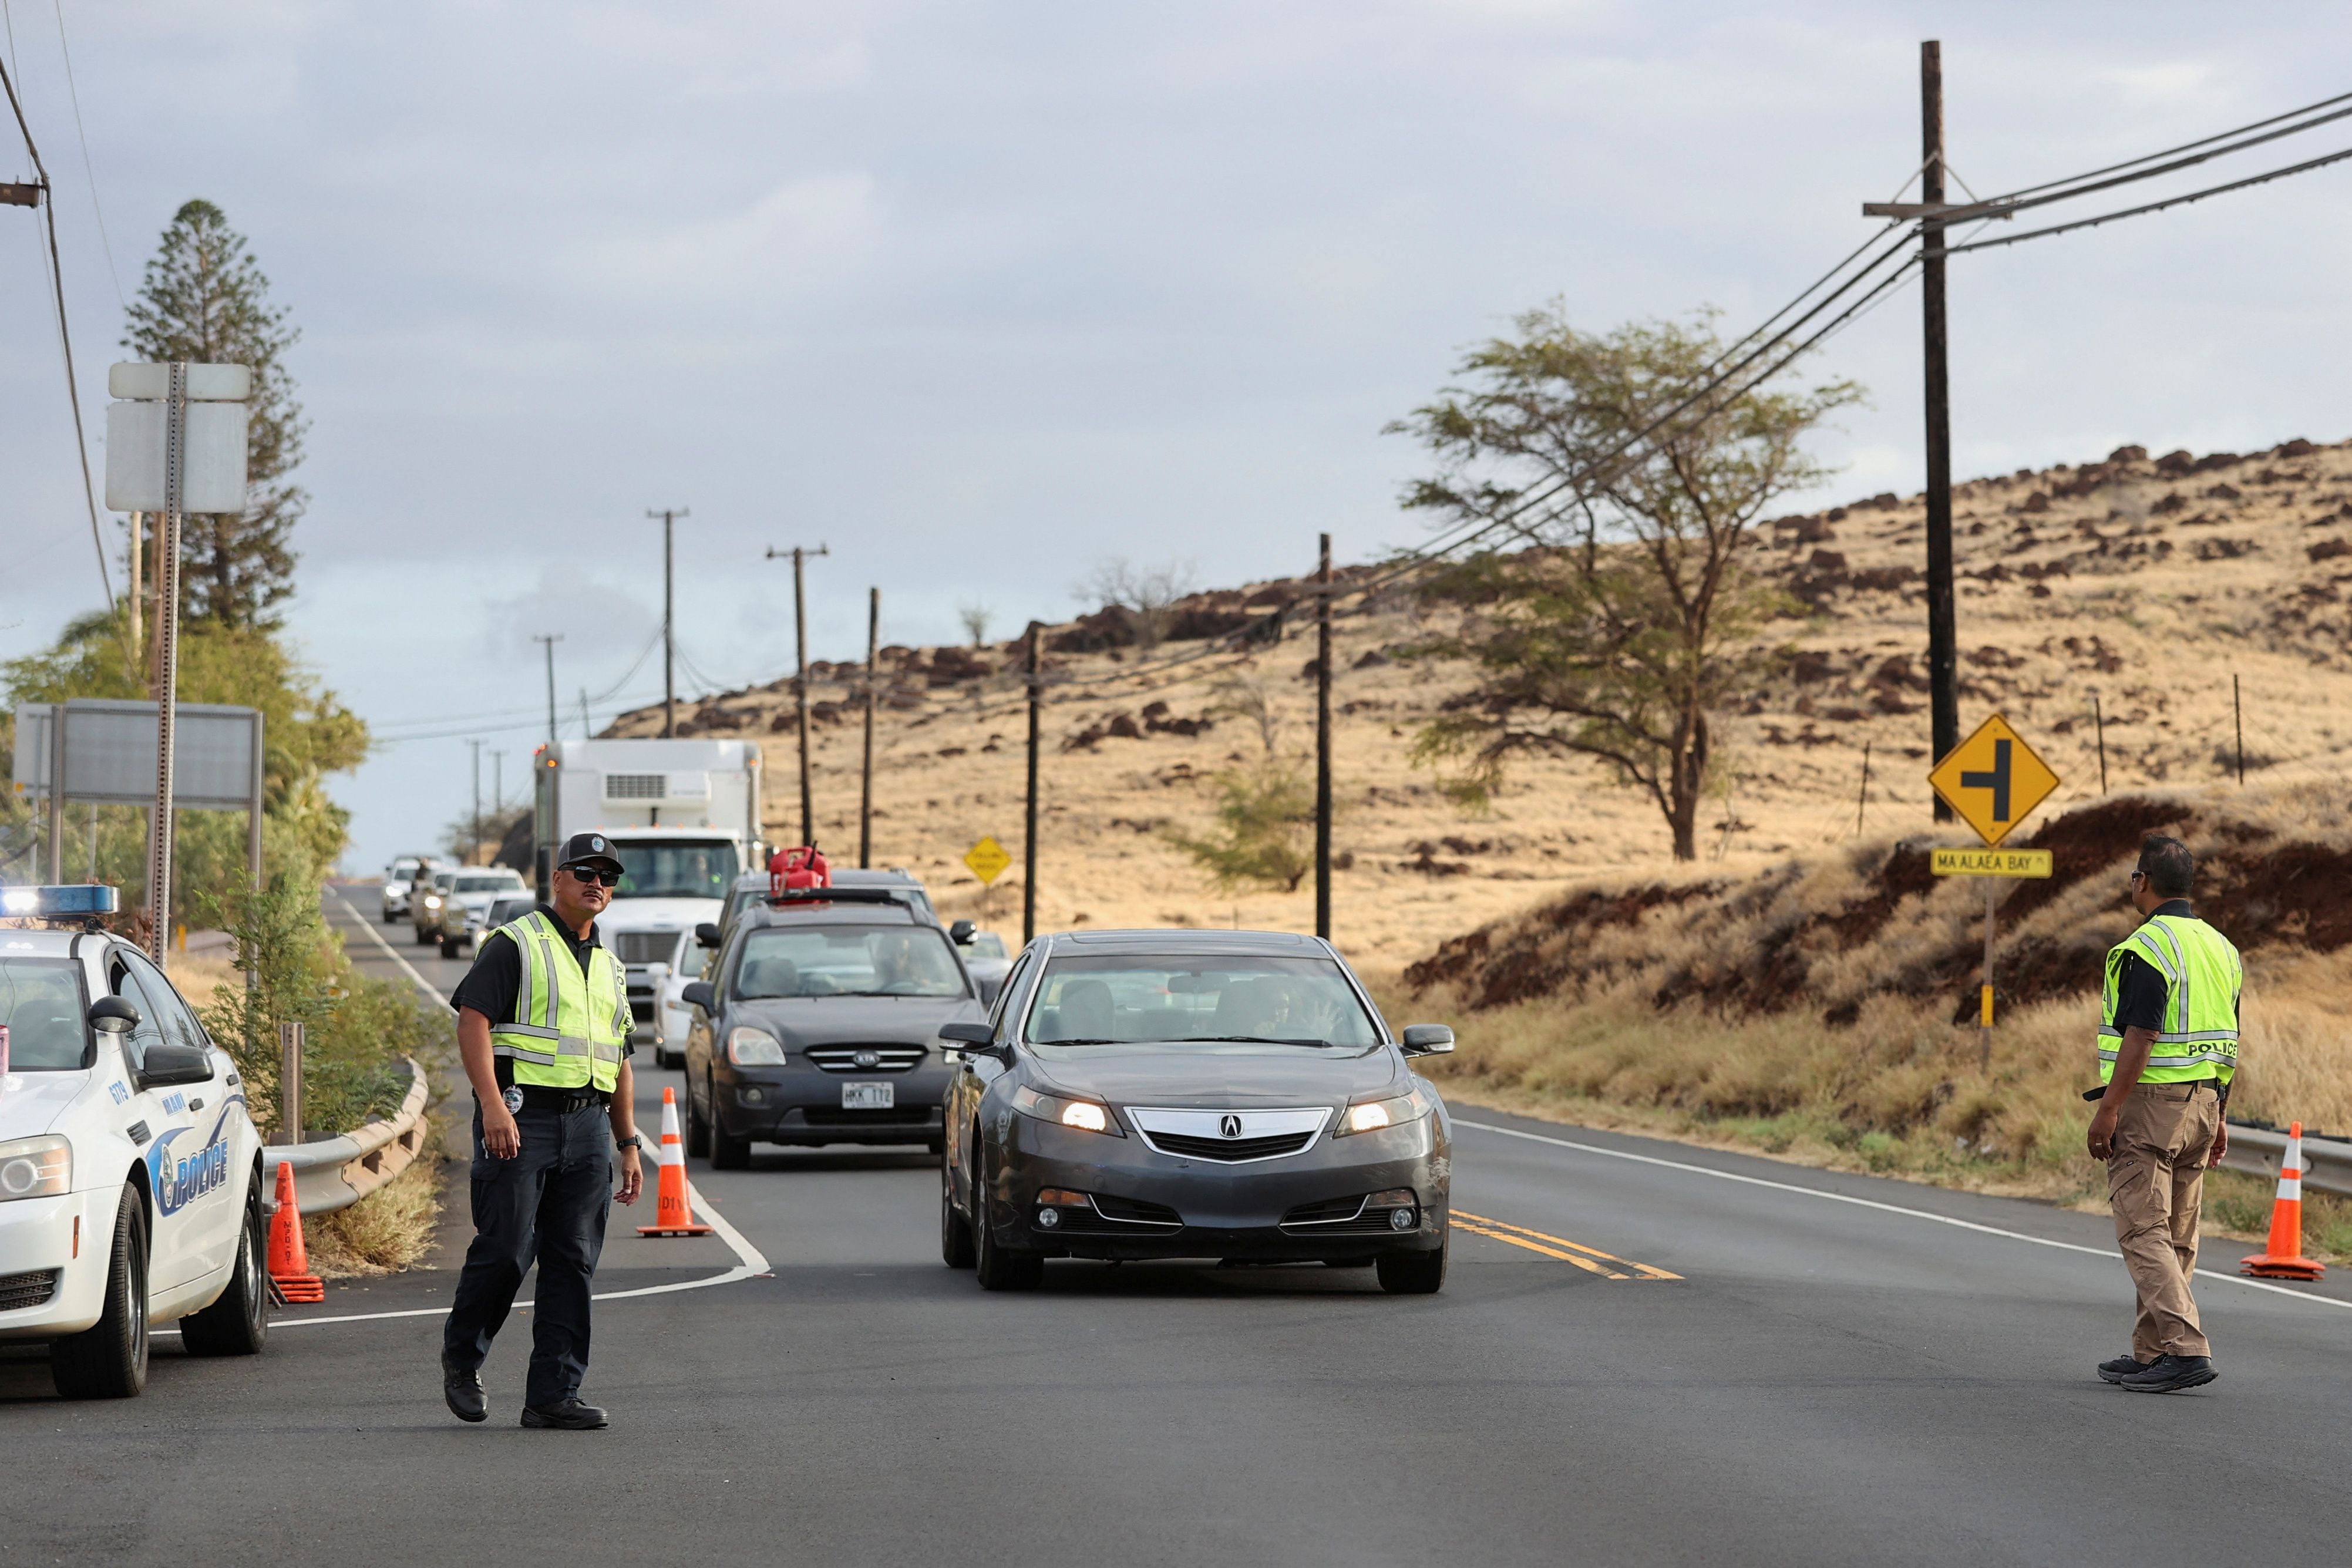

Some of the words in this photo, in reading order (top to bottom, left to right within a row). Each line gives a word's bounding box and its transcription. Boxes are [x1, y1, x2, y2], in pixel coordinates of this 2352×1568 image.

[2008, 855, 2032, 870] BAY
[617, 964, 631, 1028] POLICE
[2188, 1042, 2237, 1056] POLICE
[109, 1081, 129, 1105] 6779
[161, 1091, 187, 1116] MAUI
[176, 1137, 228, 1208] POLICE
